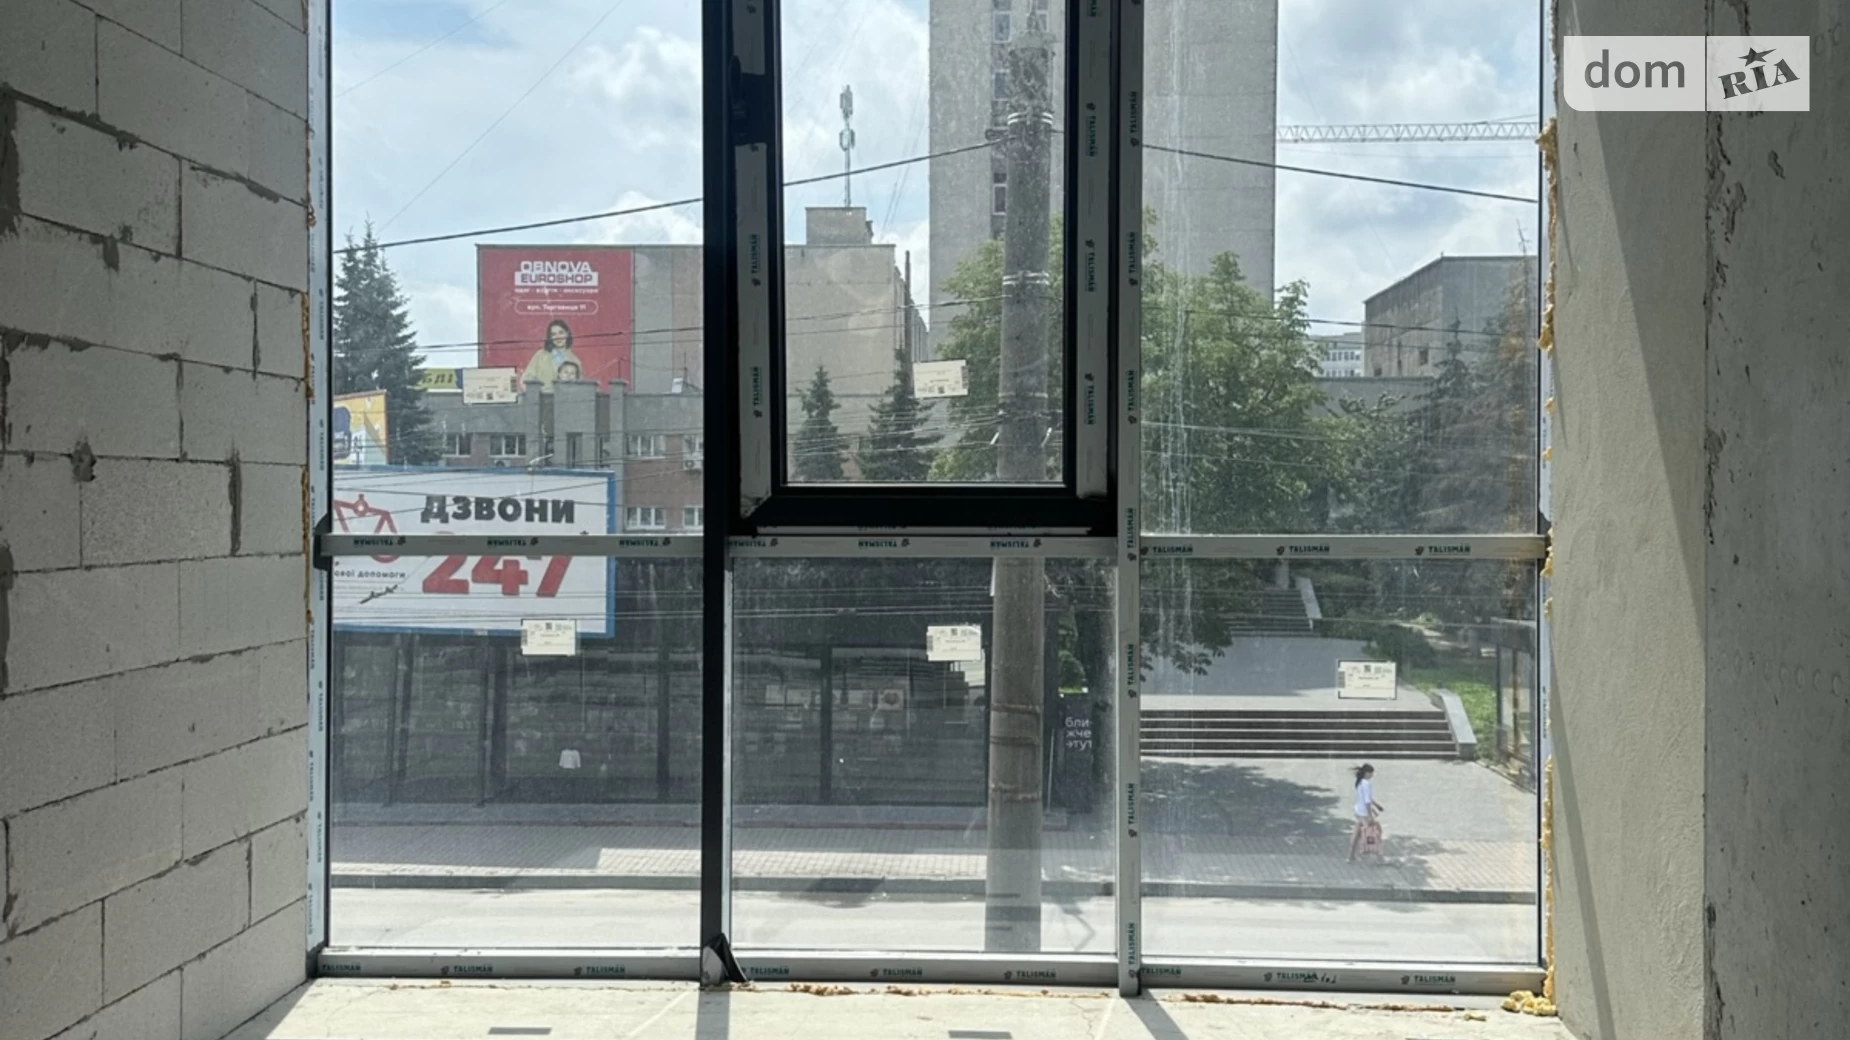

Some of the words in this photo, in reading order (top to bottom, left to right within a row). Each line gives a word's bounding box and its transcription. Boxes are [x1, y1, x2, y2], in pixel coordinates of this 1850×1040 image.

[520, 260, 592, 273] OBNOVA
[520, 273, 593, 284] EUROSHOP
[1127, 369, 1135, 411] TALISMAN
[420, 495, 575, 524] ДЗВОНИ
[1126, 507, 1134, 549] TALISMAN
[858, 539, 898, 548] TALISMAN
[989, 540, 1030, 549] TALISMAN
[1289, 543, 1330, 553] TALISMAN
[1152, 544, 1194, 554] TALISMAN
[1428, 544, 1471, 554] TALISMAN
[357, 570, 406, 578] допомоги
[1127, 643, 1135, 686] TALISMAN
[1065, 729, 1092, 738] жче
[1127, 922, 1136, 965] TALISMAN
[882, 967, 923, 977] TALISMAN
[1016, 969, 1057, 979] TALISMAN
[1414, 974, 1456, 984] TALISMAN
